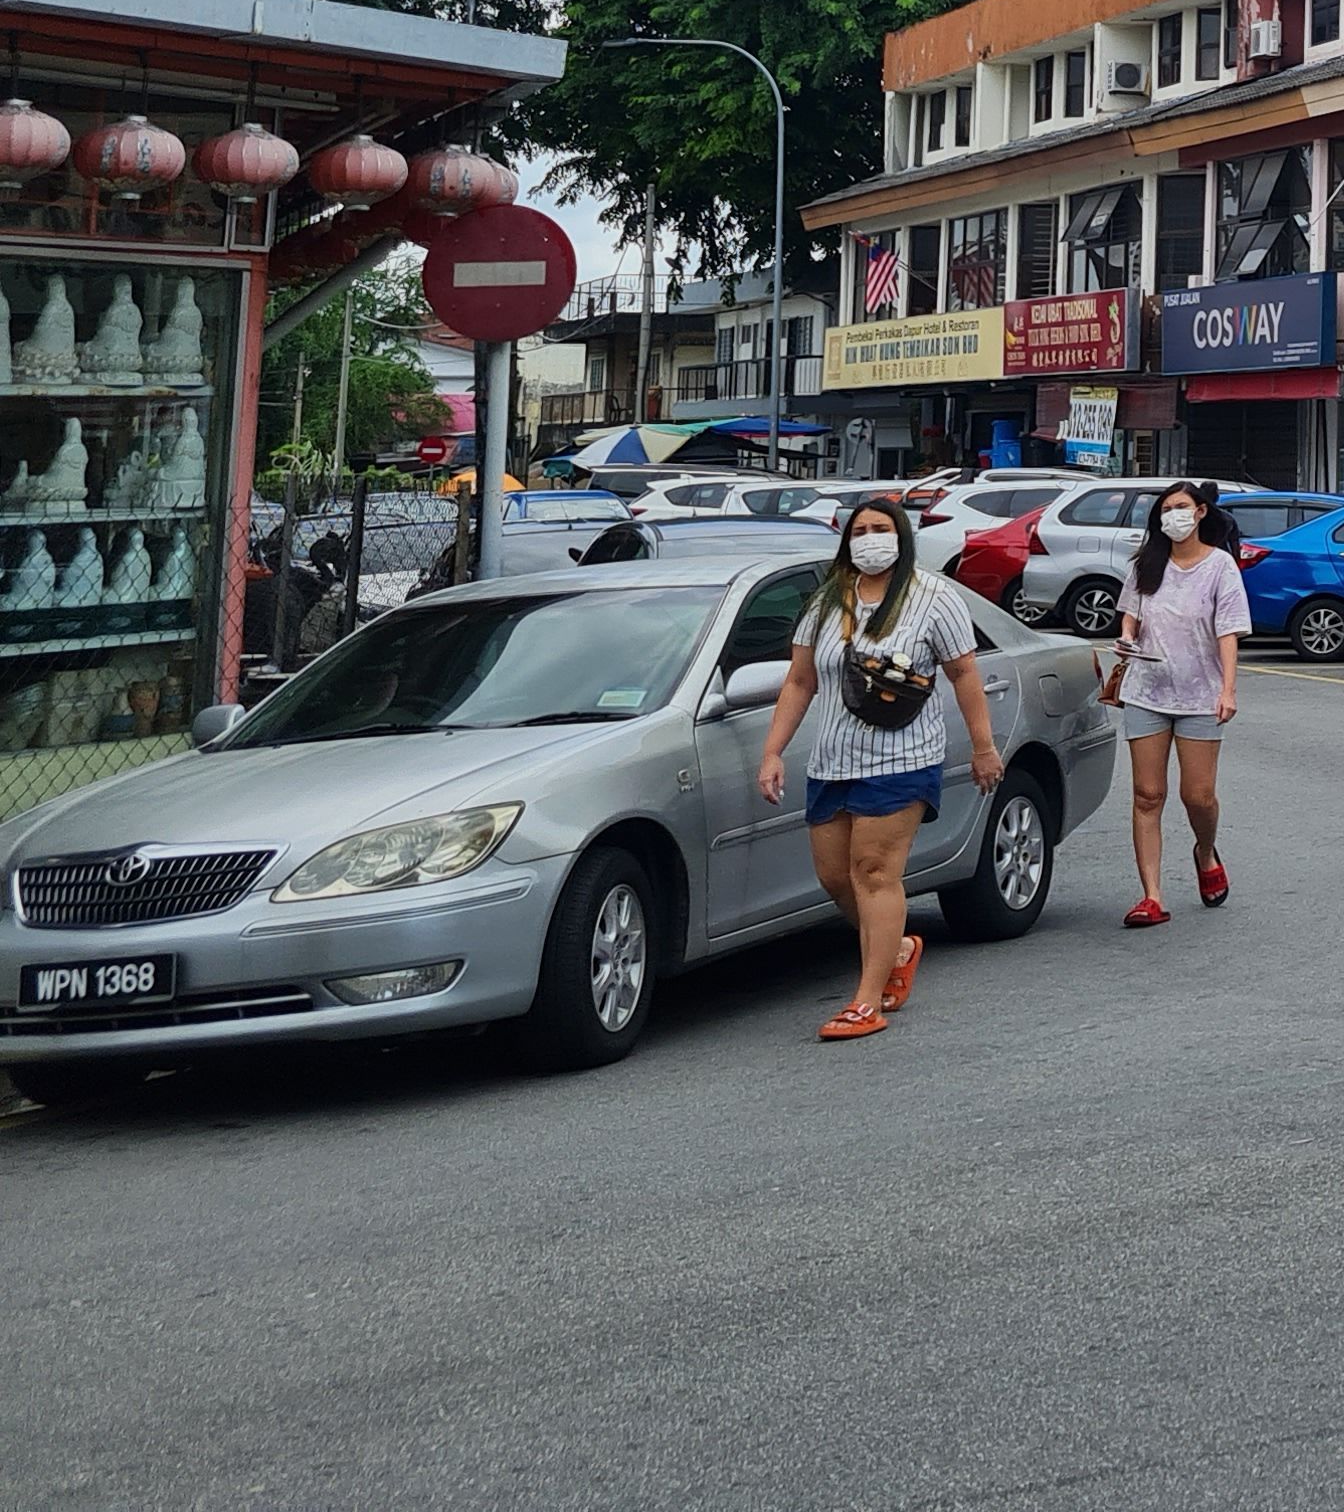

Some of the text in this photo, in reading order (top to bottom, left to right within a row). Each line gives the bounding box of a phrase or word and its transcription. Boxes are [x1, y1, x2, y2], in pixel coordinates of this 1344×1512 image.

[846, 320, 980, 344] Pembekal Perkakas Dapur Hotel & Restoran
[1193, 302, 1285, 350] COSWAY
[902, 337, 940, 359] TEMBIKAR
[942, 335, 960, 356] SDN
[962, 334, 979, 355] BHD
[37, 962, 155, 1001] WPN 1368
